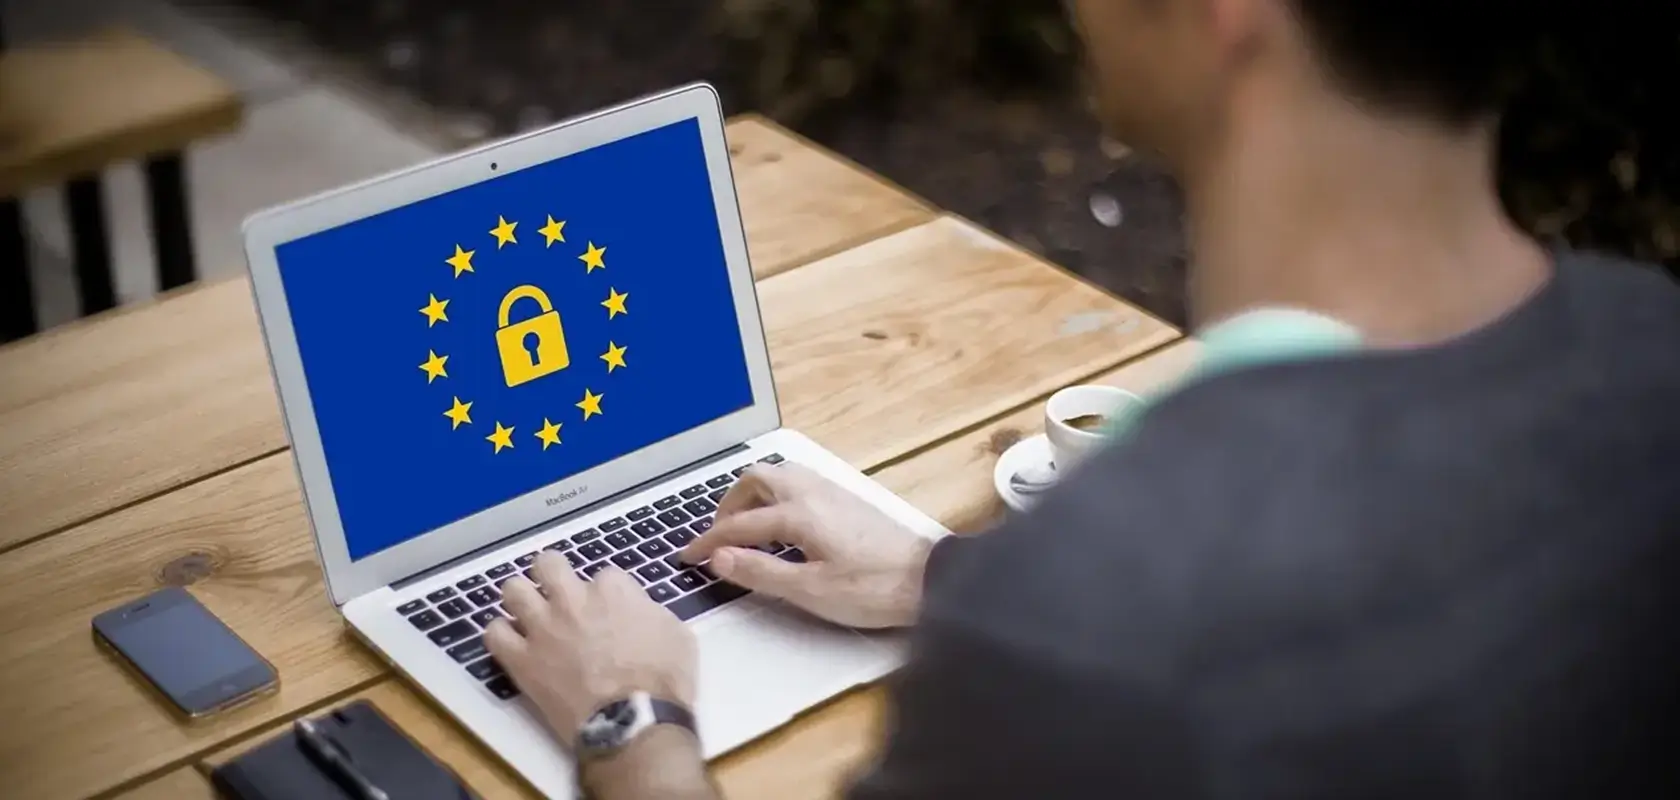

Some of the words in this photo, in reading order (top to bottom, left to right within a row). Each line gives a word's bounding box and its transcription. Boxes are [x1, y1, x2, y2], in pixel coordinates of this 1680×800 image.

[545, 488, 578, 507] MacBook
[649, 543, 659, 551] U
[649, 566, 660, 574] H
